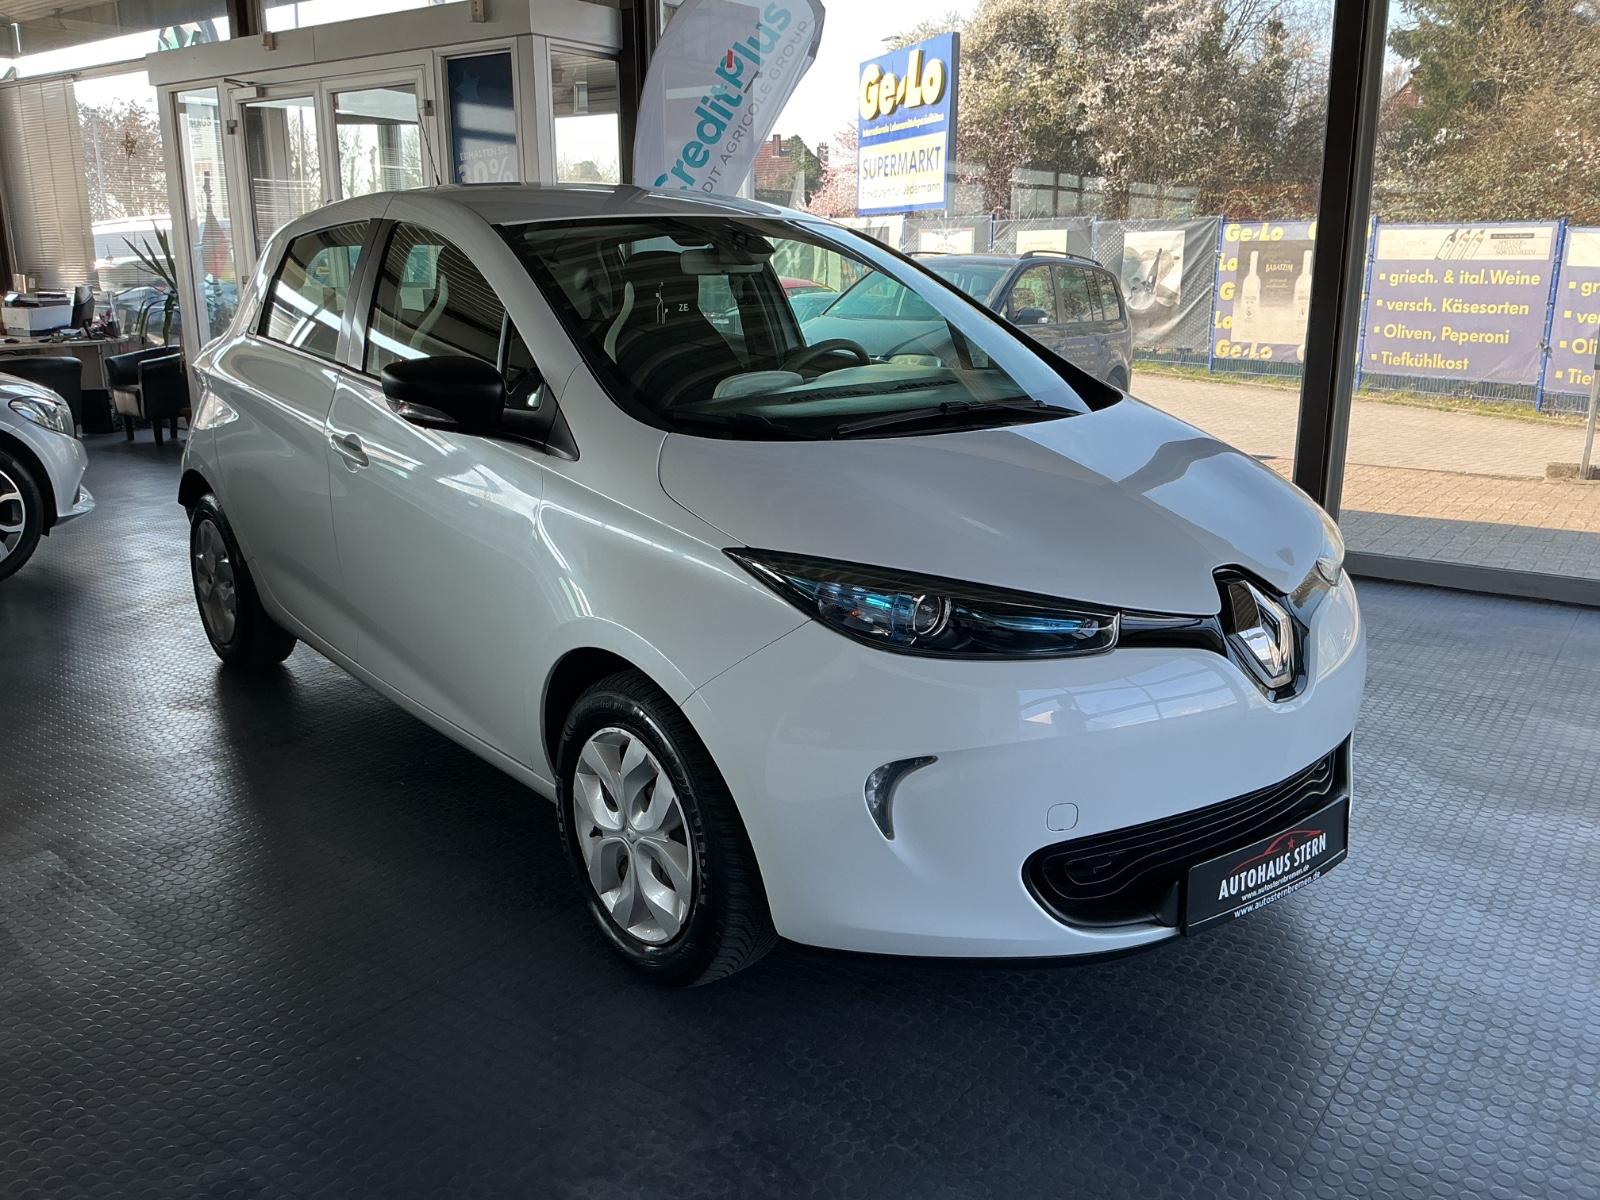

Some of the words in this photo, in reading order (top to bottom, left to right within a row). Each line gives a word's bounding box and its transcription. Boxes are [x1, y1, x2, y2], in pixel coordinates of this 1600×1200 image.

[720, 82, 773, 166] AGRICOLE
[769, 21, 808, 80] GROUP
[863, 146, 942, 180] SUPERMARKT
[1389, 269, 1438, 286] griech.
[1443, 271, 1455, 285] &
[1387, 297, 1437, 313] versch.
[1441, 297, 1530, 315] Käsesorten
[1383, 323, 1437, 342] Oliven,
[1441, 326, 1510, 346] Peperoni
[1381, 351, 1470, 371] Tiefkühlkost
[1218, 852, 1291, 900] AUTOHAUS
[1294, 832, 1327, 867] STERN
[1241, 864, 1310, 901] www.autosternbremen.de
[1233, 870, 1321, 918] www.autosternbremen.de
